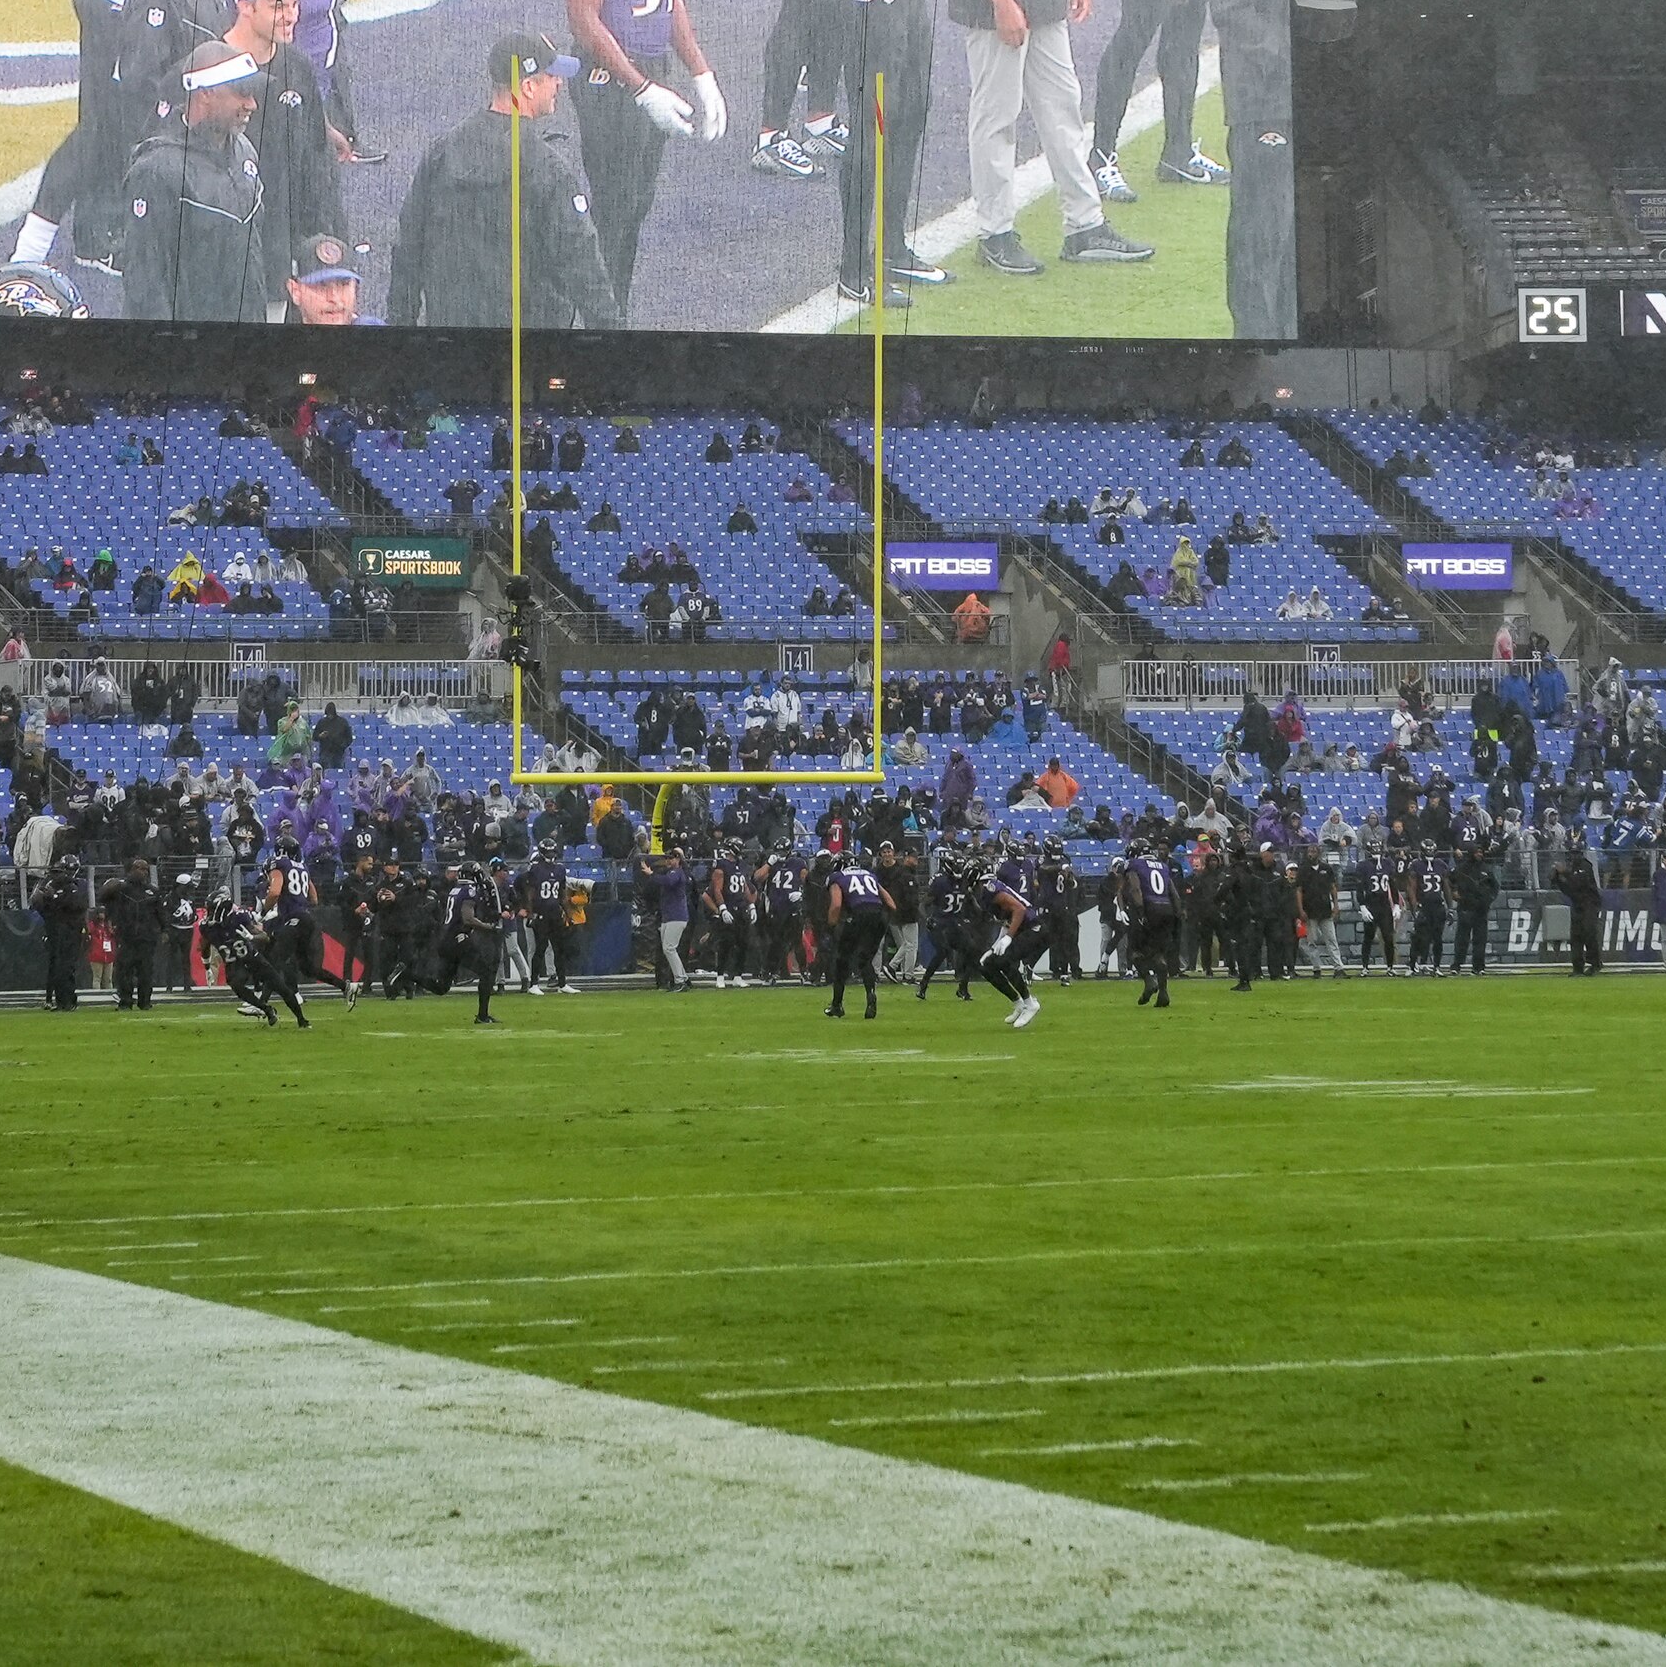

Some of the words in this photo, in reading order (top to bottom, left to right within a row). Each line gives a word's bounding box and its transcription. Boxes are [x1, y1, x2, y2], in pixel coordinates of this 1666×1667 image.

[1528, 297, 1574, 335] 25
[384, 549, 431, 562] CAESARS
[384, 559, 462, 576] SPORTSBOOK
[890, 558, 920, 575] PIT
[927, 558, 991, 574] BOSS
[1407, 558, 1438, 574] PIT
[1442, 558, 1504, 574] BOSS
[687, 598, 703, 612] 89
[785, 649, 810, 671] 141
[97, 679, 114, 692] 52
[356, 833, 372, 848] 89
[1462, 827, 1477, 841] 25
[288, 870, 310, 896] 88
[772, 870, 793, 889] 42
[847, 873, 879, 897] 40
[1150, 870, 1163, 895] 0
